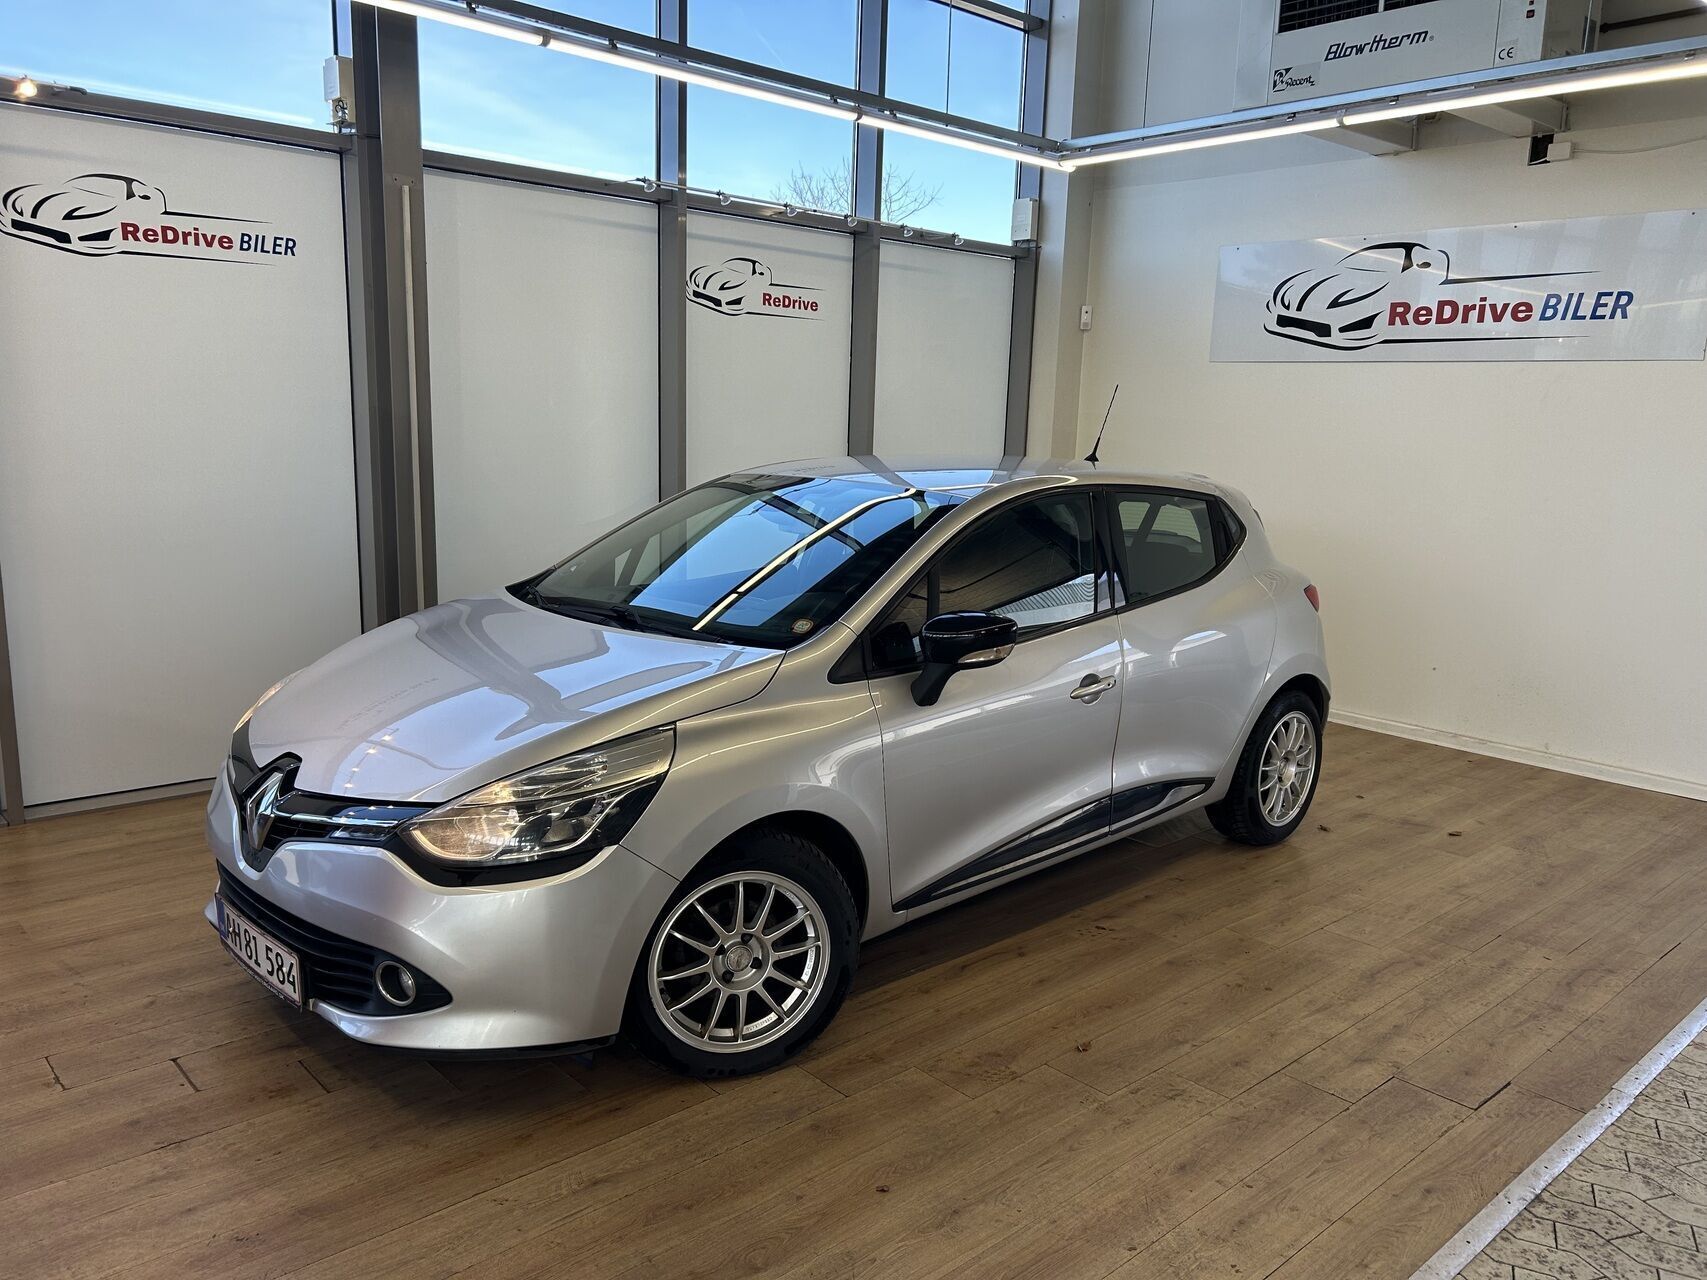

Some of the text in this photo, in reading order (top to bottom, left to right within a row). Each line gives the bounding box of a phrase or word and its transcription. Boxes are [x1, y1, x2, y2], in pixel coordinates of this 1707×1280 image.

[1324, 30, 1429, 62] Blowtherm
[1498, 46, 1515, 61] CE
[120, 221, 297, 257] ReDrive BILER
[762, 292, 819, 312] ReDrive
[1387, 290, 1635, 327] ReDrive BILER
[226, 912, 242, 952] AH
[244, 928, 262, 969] 81
[265, 944, 297, 994] 584
